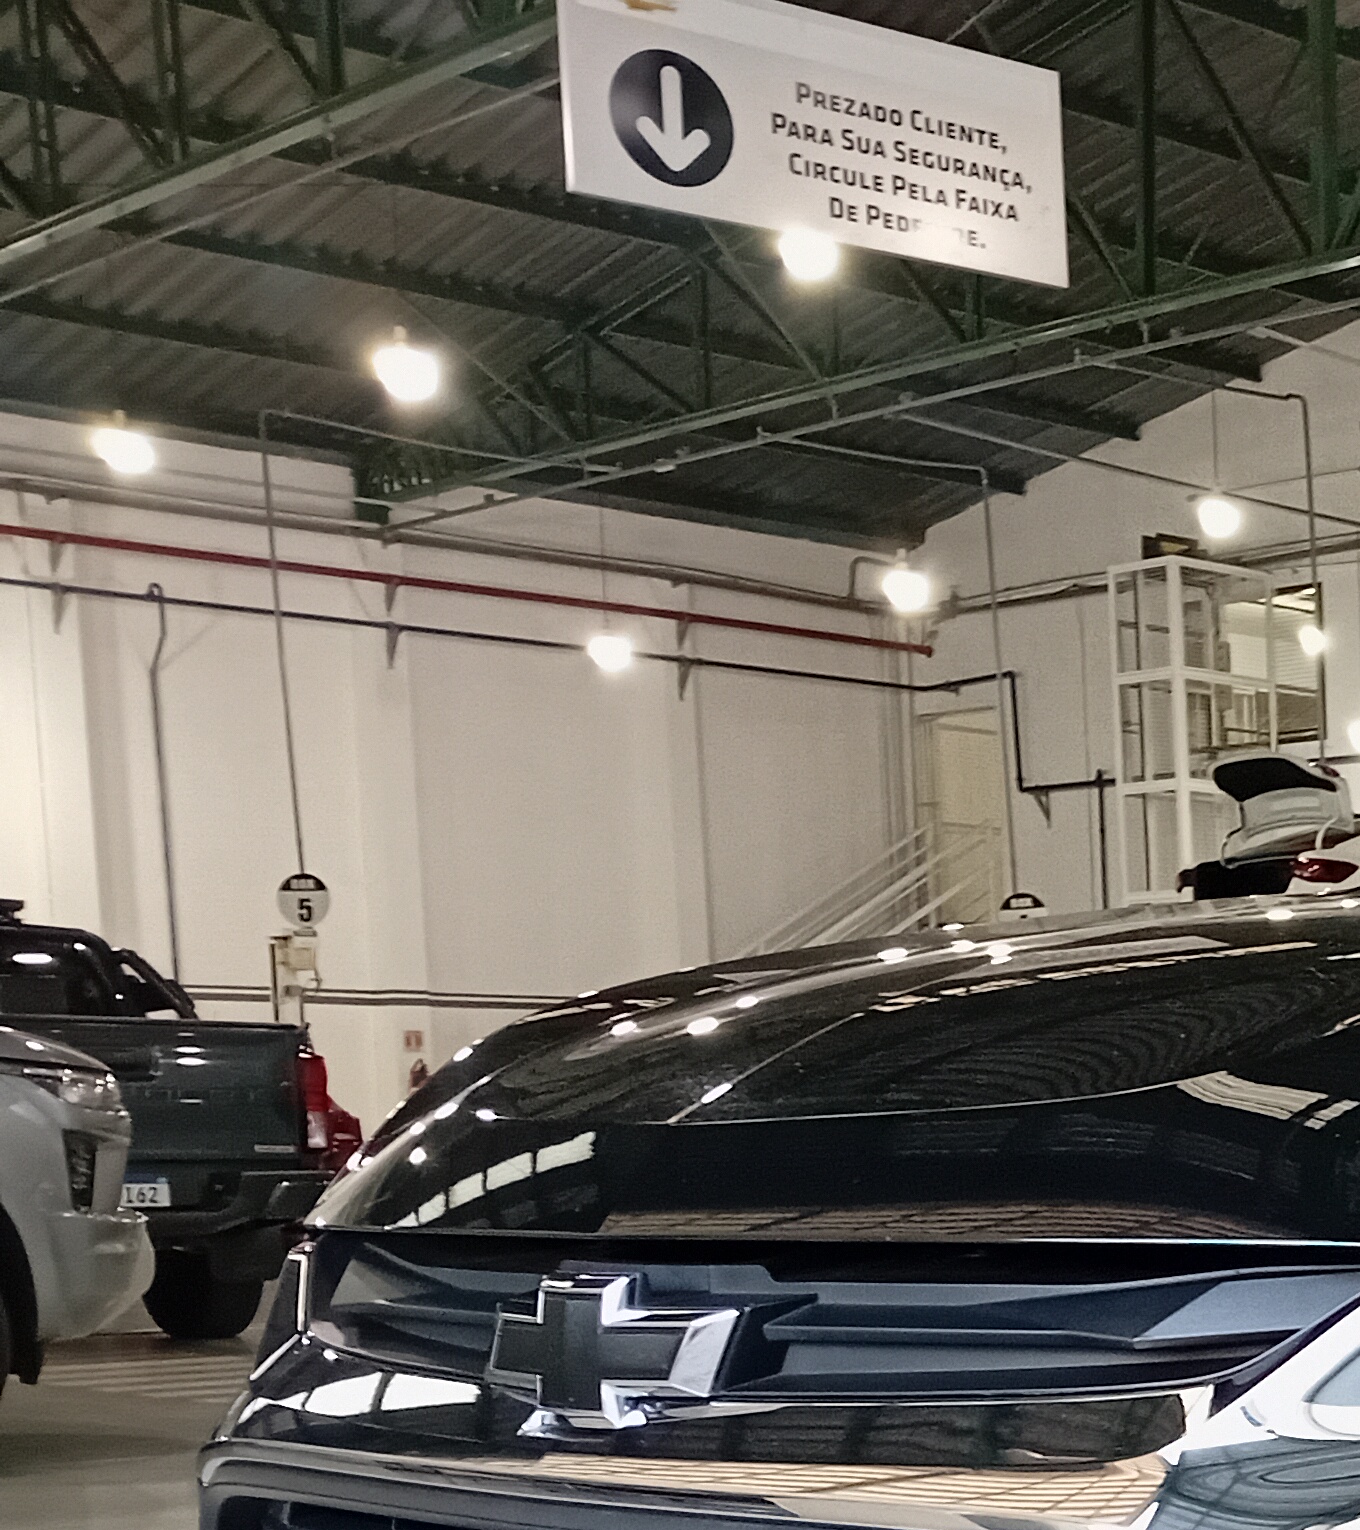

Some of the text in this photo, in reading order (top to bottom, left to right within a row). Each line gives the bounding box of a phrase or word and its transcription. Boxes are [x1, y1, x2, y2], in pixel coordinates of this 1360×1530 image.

[796, 82, 1007, 154] PREZADO CLIENTE,
[771, 112, 1032, 194] PARA SUA SEGURANÇA,
[788, 153, 1019, 221] CIRCULE PELA FAIXA
[829, 197, 986, 248] DE PEDE.
[297, 898, 312, 922] 5
